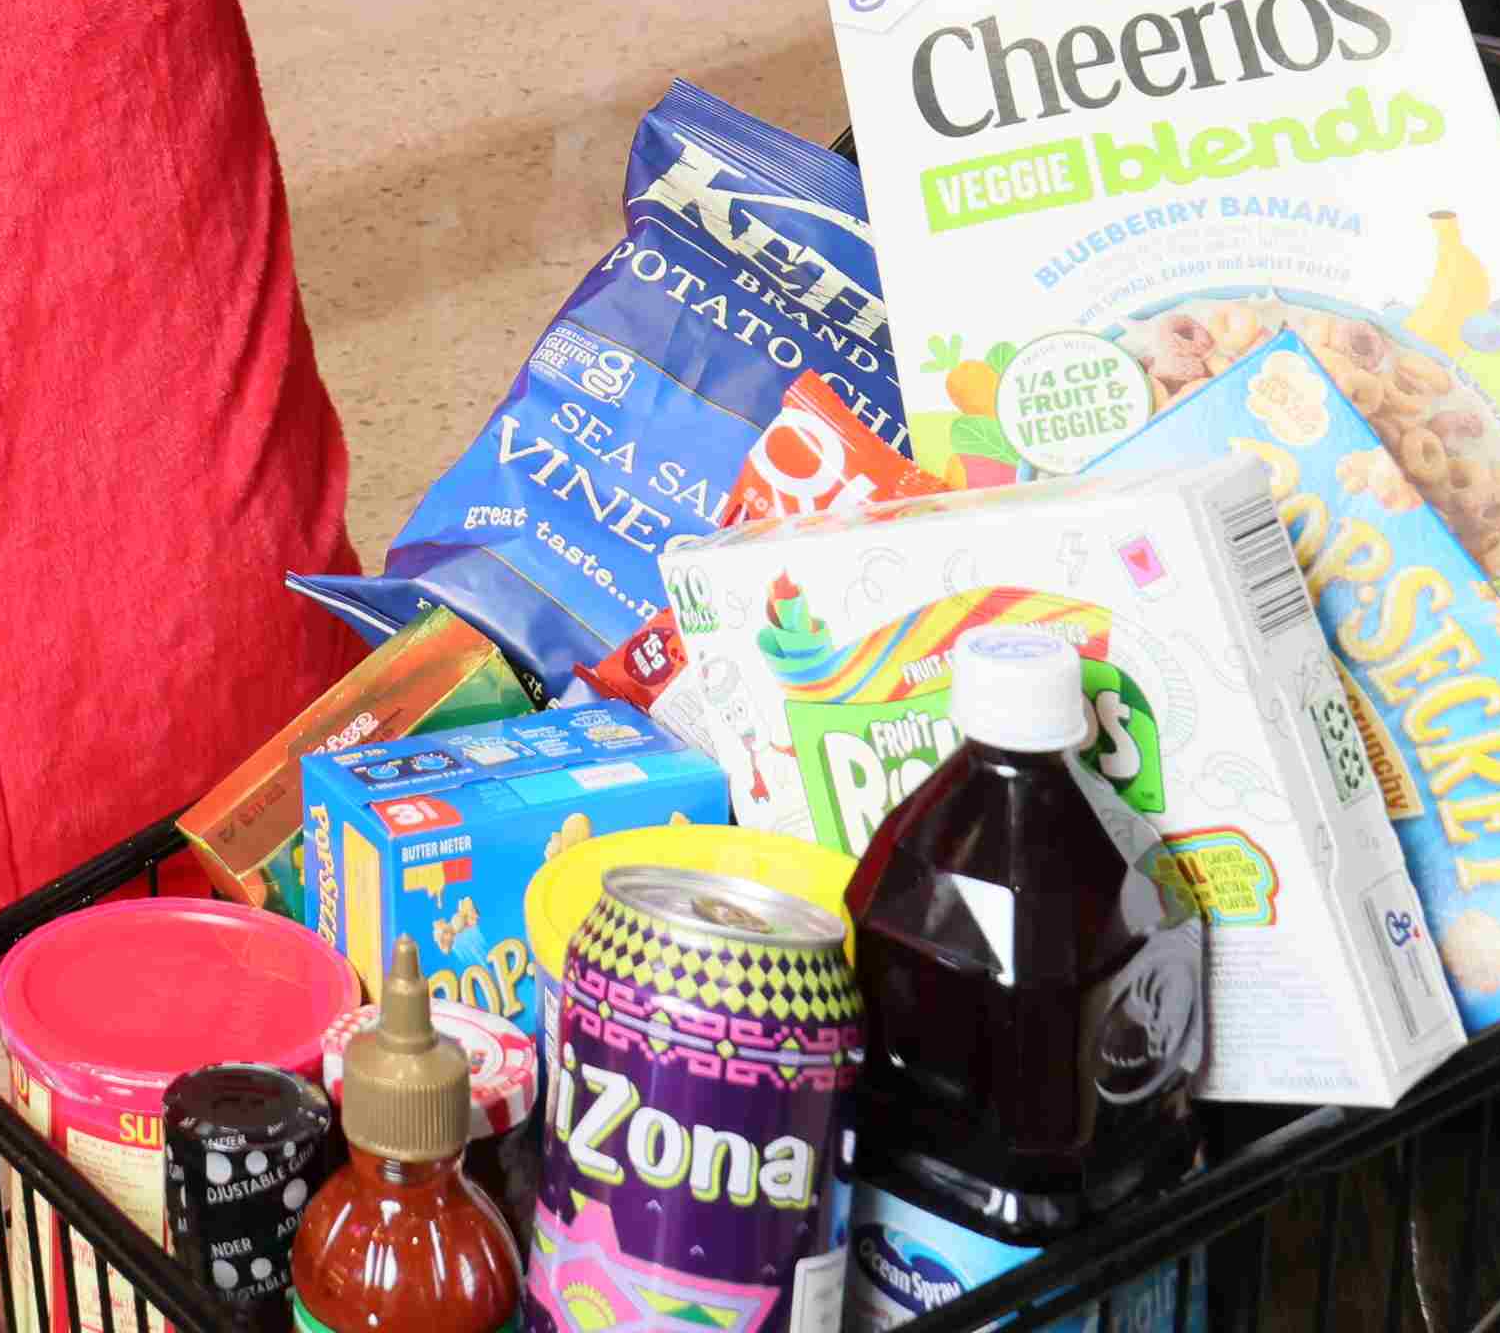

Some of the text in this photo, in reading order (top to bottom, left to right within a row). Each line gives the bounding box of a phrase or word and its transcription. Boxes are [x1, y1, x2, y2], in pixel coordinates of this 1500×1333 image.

[936, 85, 1447, 217] VEGGIE blends
[1032, 195, 1362, 289] BLUEBERRY BANANA
[600, 240, 804, 369] POTATO
[733, 268, 880, 374] BRAND
[539, 348, 568, 369] FREE
[545, 337, 596, 366] GLUTEN
[1015, 357, 1120, 396] 1/4 CUP
[1017, 385, 1099, 417] FRUIT
[549, 400, 637, 475] SEA
[464, 504, 529, 531] great
[402, 834, 472, 863] BUTTER METER
